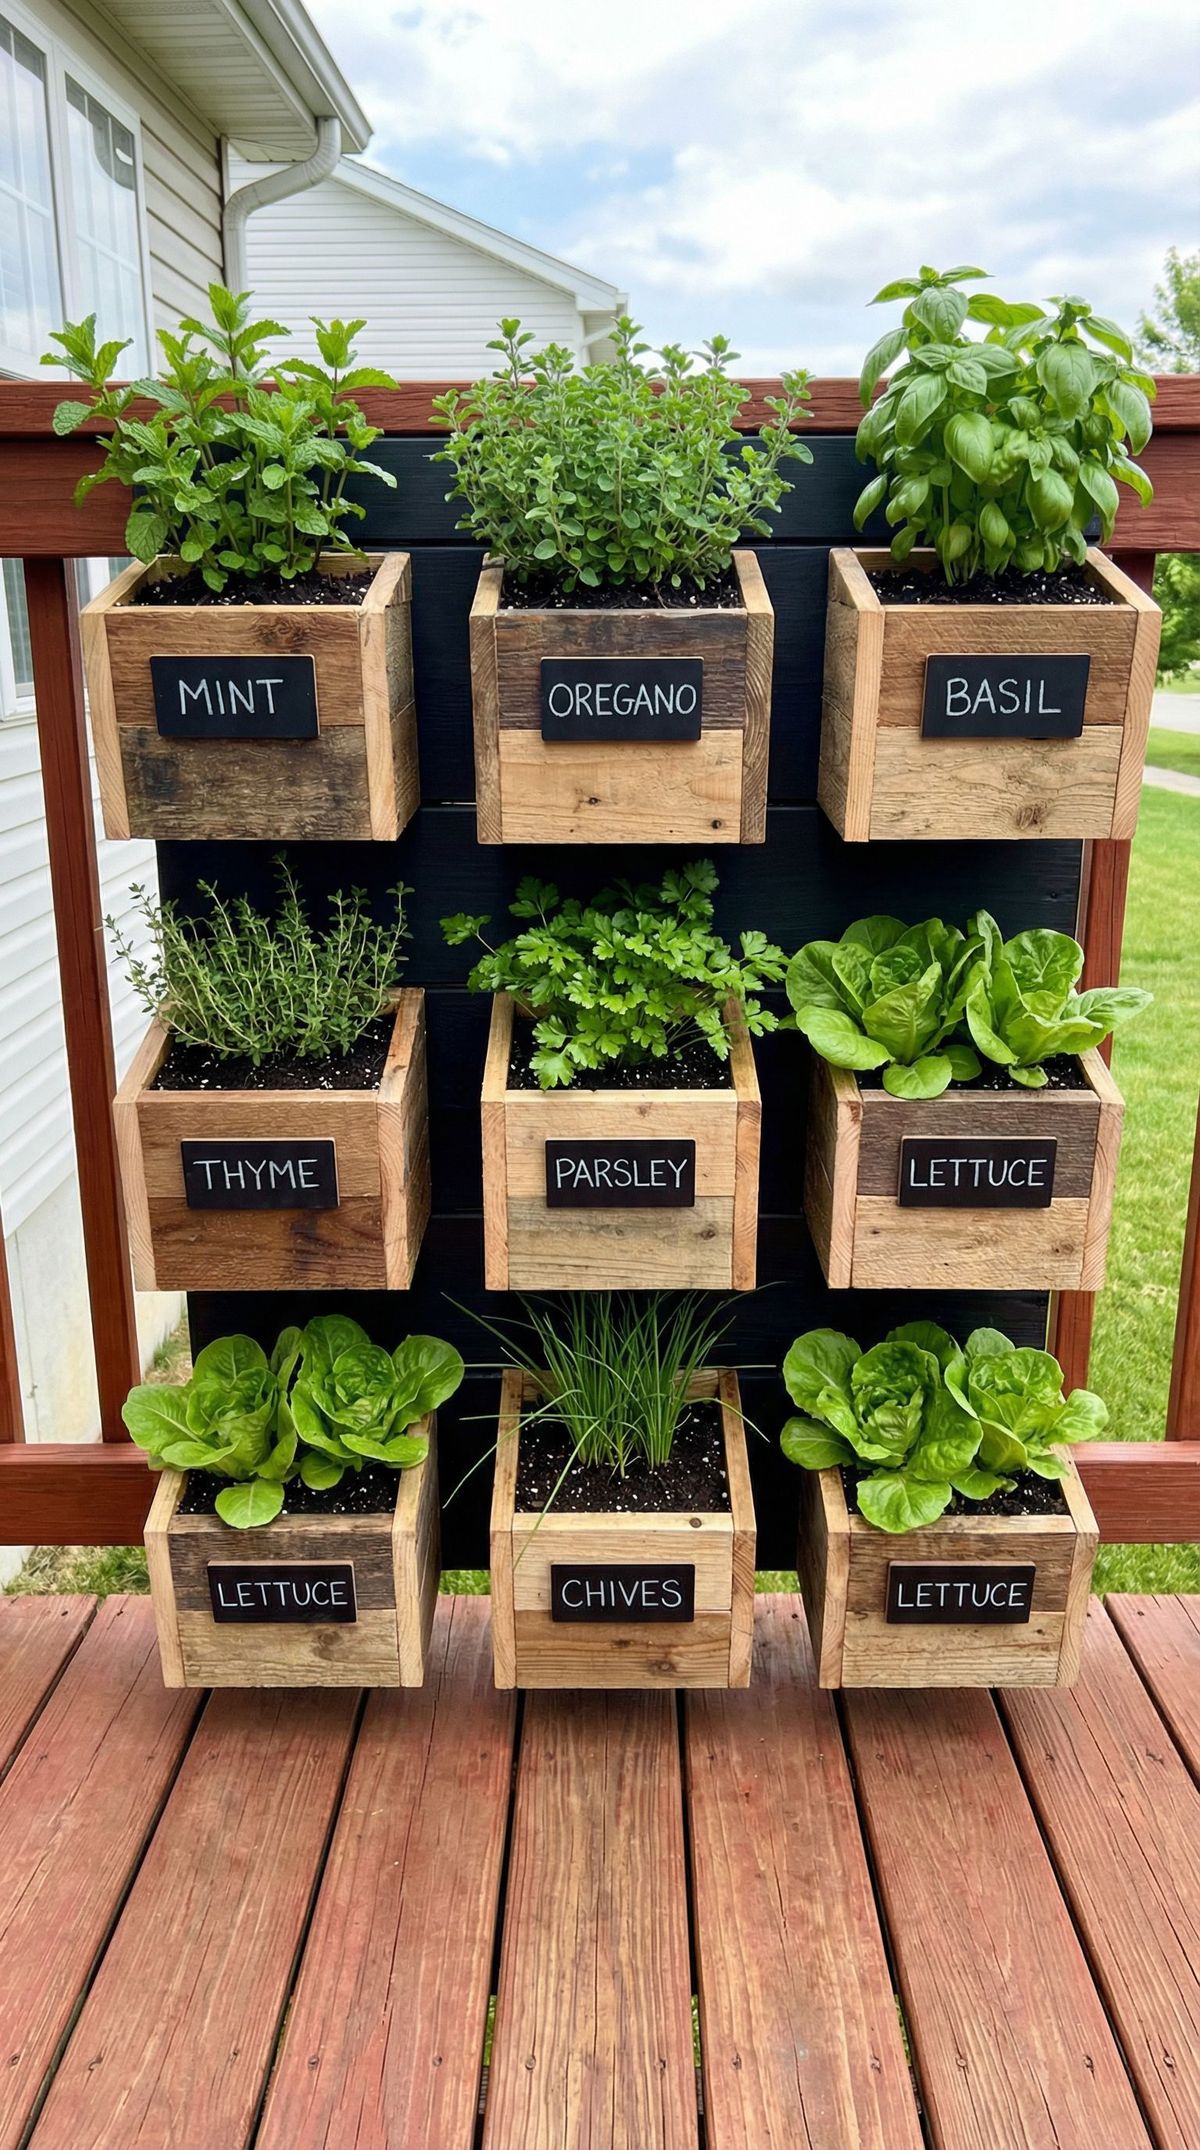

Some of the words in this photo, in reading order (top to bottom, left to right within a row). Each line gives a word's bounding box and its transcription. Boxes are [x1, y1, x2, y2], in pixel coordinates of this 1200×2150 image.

[178, 678, 284, 715] MINT
[548, 683, 697, 718] OREGANO
[946, 677, 1062, 716] BASIL
[192, 1159, 320, 1190] THYME
[555, 1158, 688, 1189] PARSLEY
[910, 1158, 1048, 1187] LETTUCE
[217, 1581, 348, 1607] LETTUCE
[561, 1579, 682, 1608] CHIVES
[898, 1582, 1025, 1608] LETTUCE
